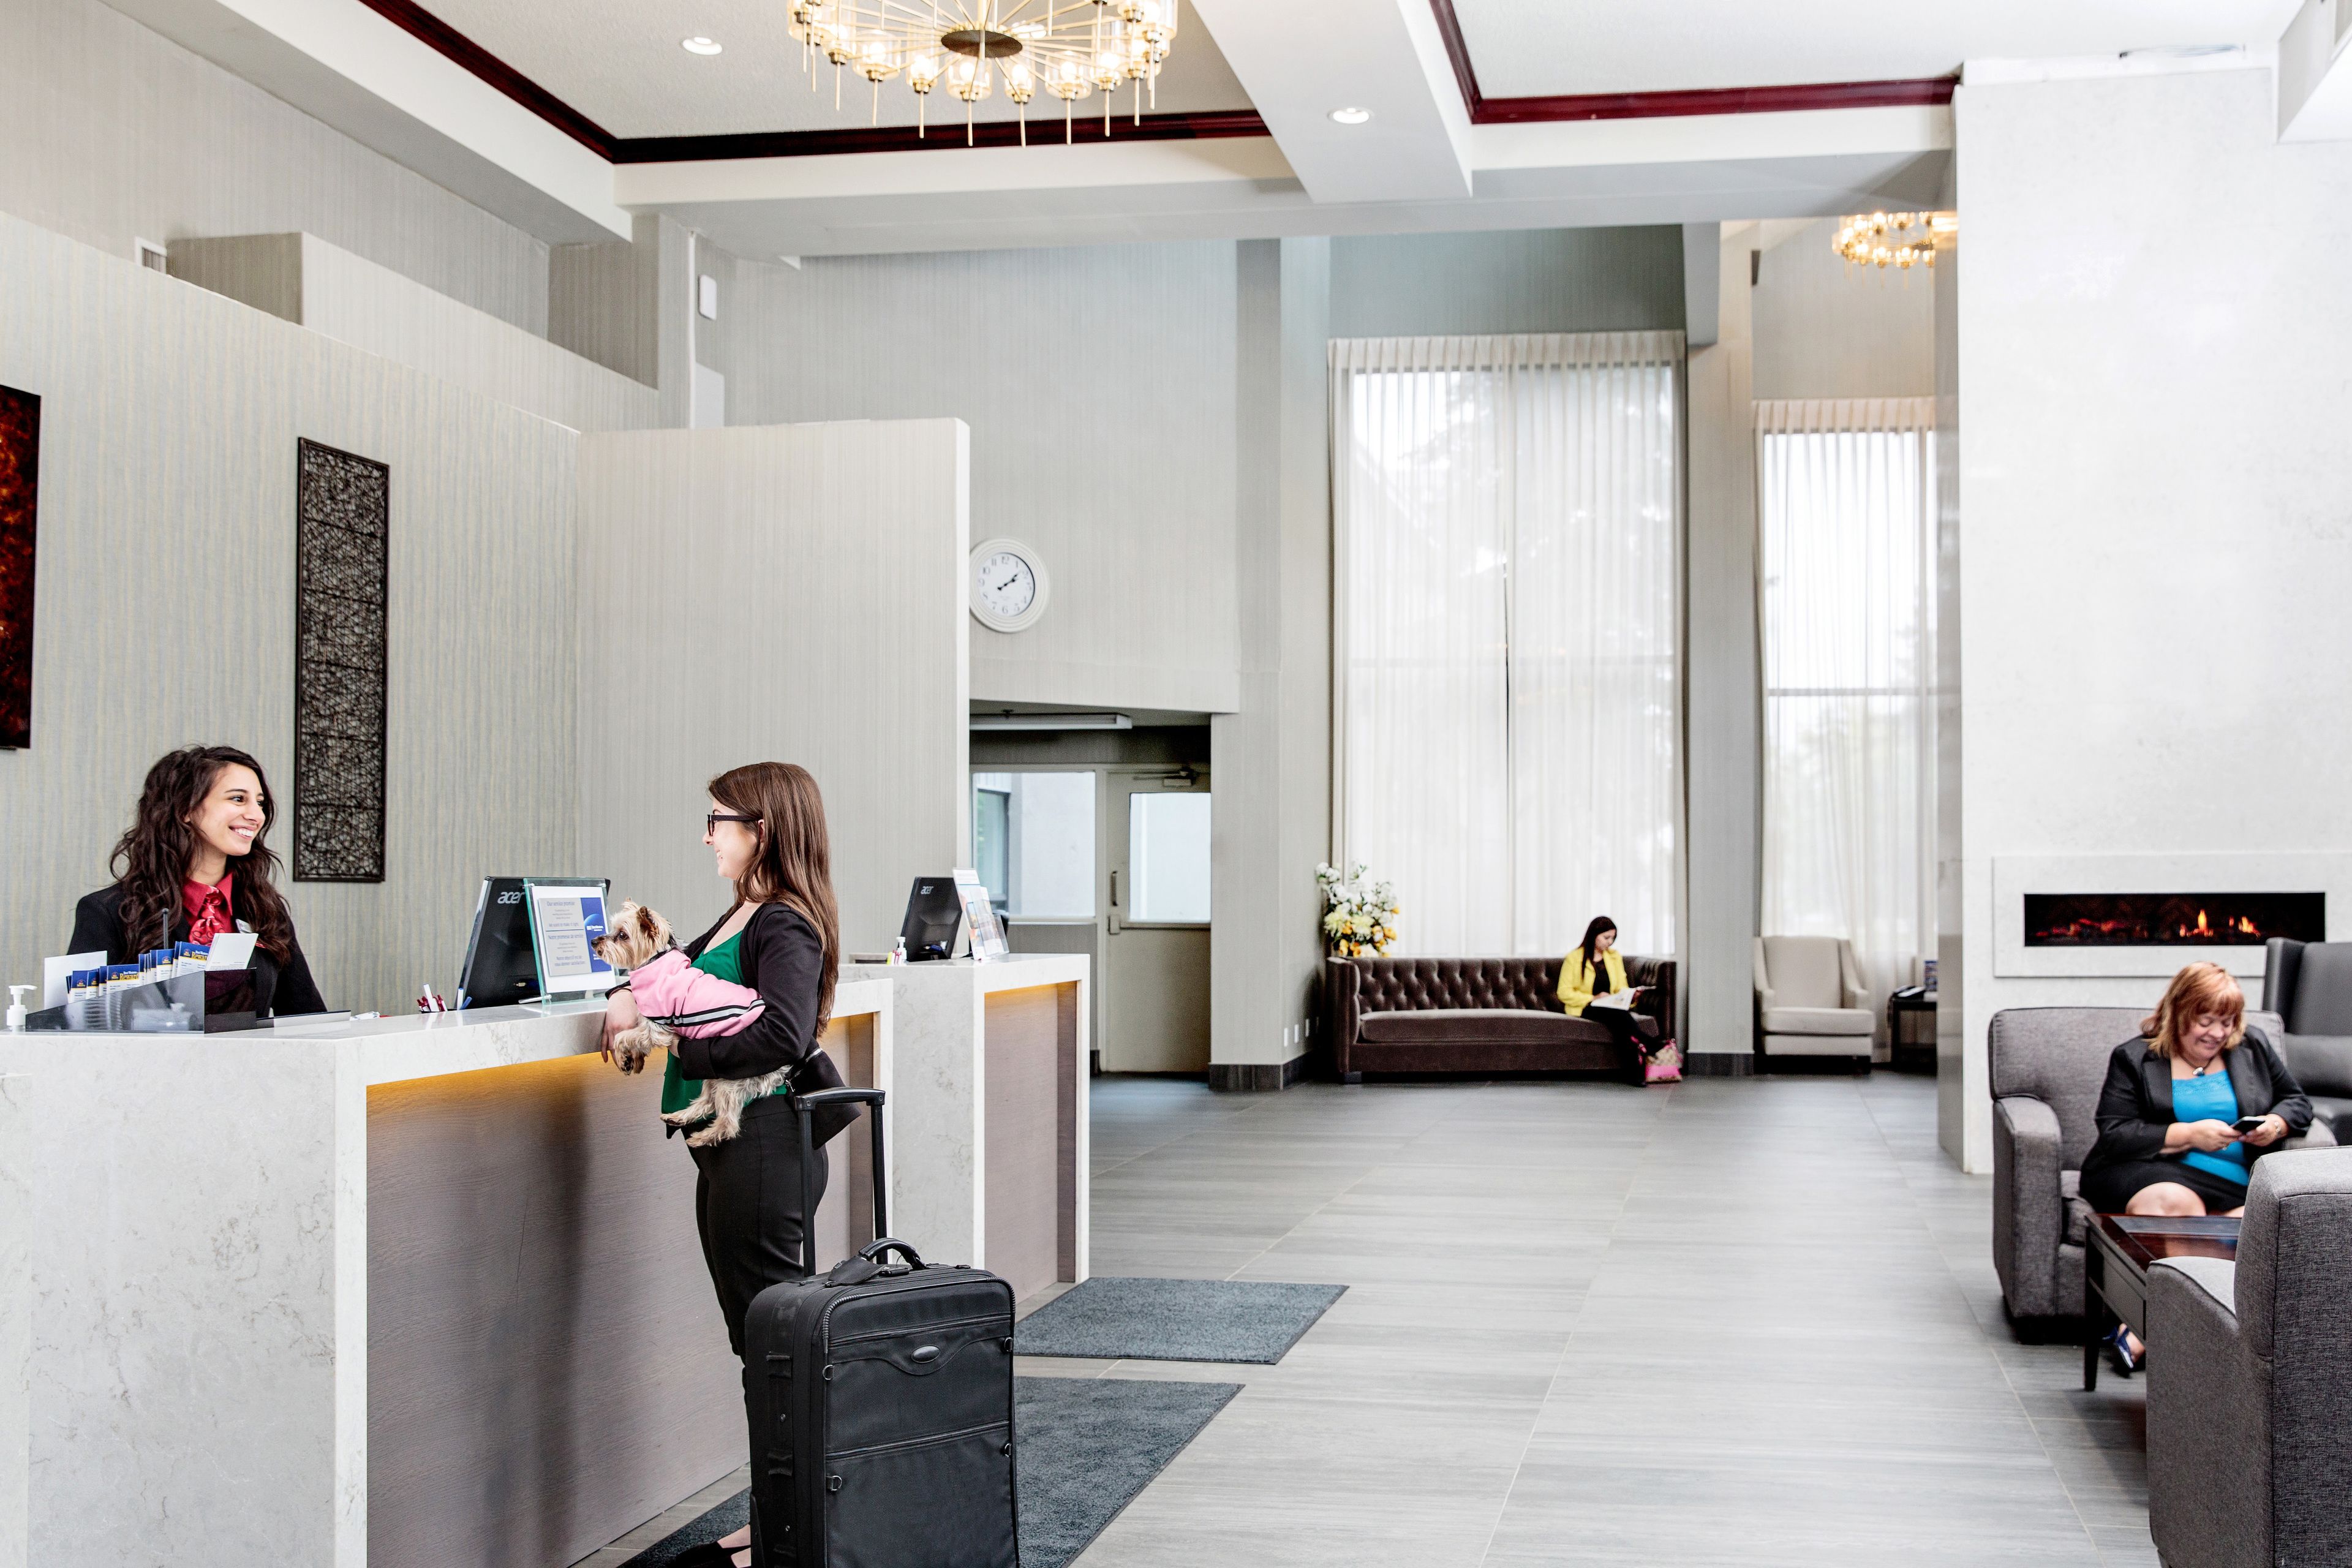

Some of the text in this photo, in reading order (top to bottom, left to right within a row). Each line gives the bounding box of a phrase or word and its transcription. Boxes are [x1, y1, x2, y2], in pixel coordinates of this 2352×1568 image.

[992, 558, 997, 567] 11
[1001, 556, 1009, 565] 12
[1016, 559, 1019, 568] 1
[978, 578, 985, 587] 9
[992, 601, 997, 610] 7
[1001, 605, 1008, 614] 6
[921, 886, 933, 894] acer
[497, 891, 526, 903] acer
